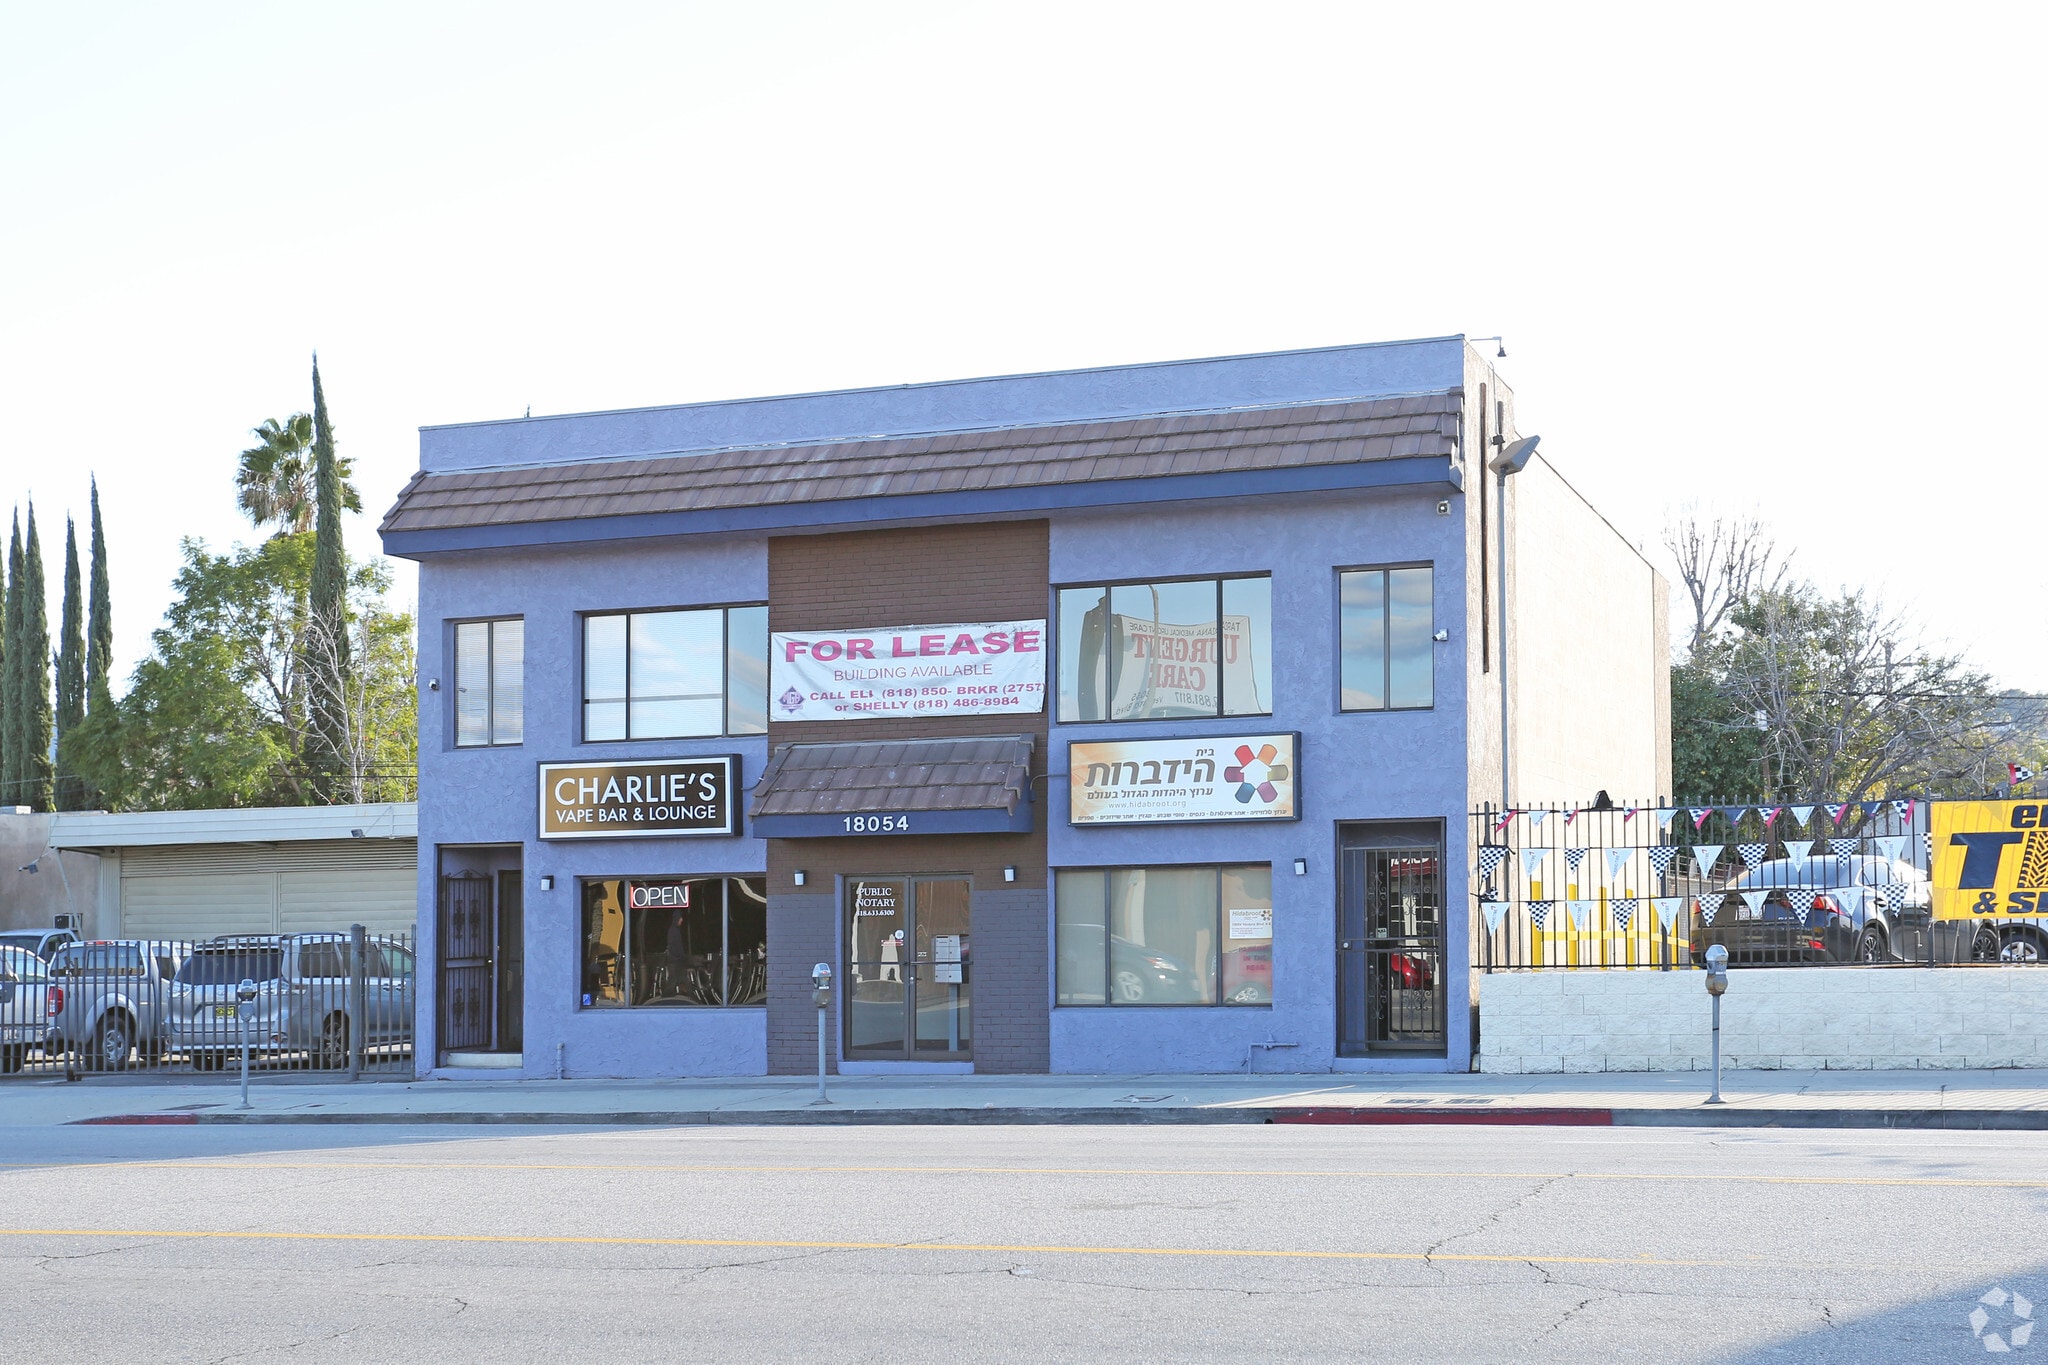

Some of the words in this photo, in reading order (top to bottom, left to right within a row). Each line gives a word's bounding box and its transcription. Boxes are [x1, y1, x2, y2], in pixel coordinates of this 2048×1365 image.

[785, 638, 876, 663] FOR
[891, 630, 1041, 659] LEASE
[834, 667, 907, 681] BUILDING
[910, 663, 993, 677] AVAILABLE
[810, 691, 846, 701] CALL
[882, 688, 918, 699] (818)
[921, 687, 952, 696] 850-
[956, 685, 999, 695] BRKR
[834, 704, 849, 712] or
[853, 701, 909, 711] SHELLY
[913, 700, 949, 710] (818)
[953, 696, 1020, 707] 486-8984
[1195, 748, 1215, 757] בית
[1084, 758, 1216, 788] הידברות
[554, 772, 717, 806] CHARLIE'S
[1086, 790, 1119, 800] בעולם
[1121, 789, 1149, 798] הגדול
[1151, 788, 1187, 798] היהדות
[1189, 787, 1214, 799] ערוץ
[1108, 800, 1187, 809] www.hidabroot.org
[555, 808, 594, 823] VAPE
[598, 807, 628, 822] BAR
[632, 807, 644, 821] &
[649, 805, 716, 821] LOUNGE
[2010, 804, 2048, 828] e
[843, 815, 909, 832] 18054
[632, 886, 688, 906] OPEN
[858, 887, 893, 896] PUBLIC
[856, 898, 896, 907] NOTARY
[1972, 891, 1999, 914] &
